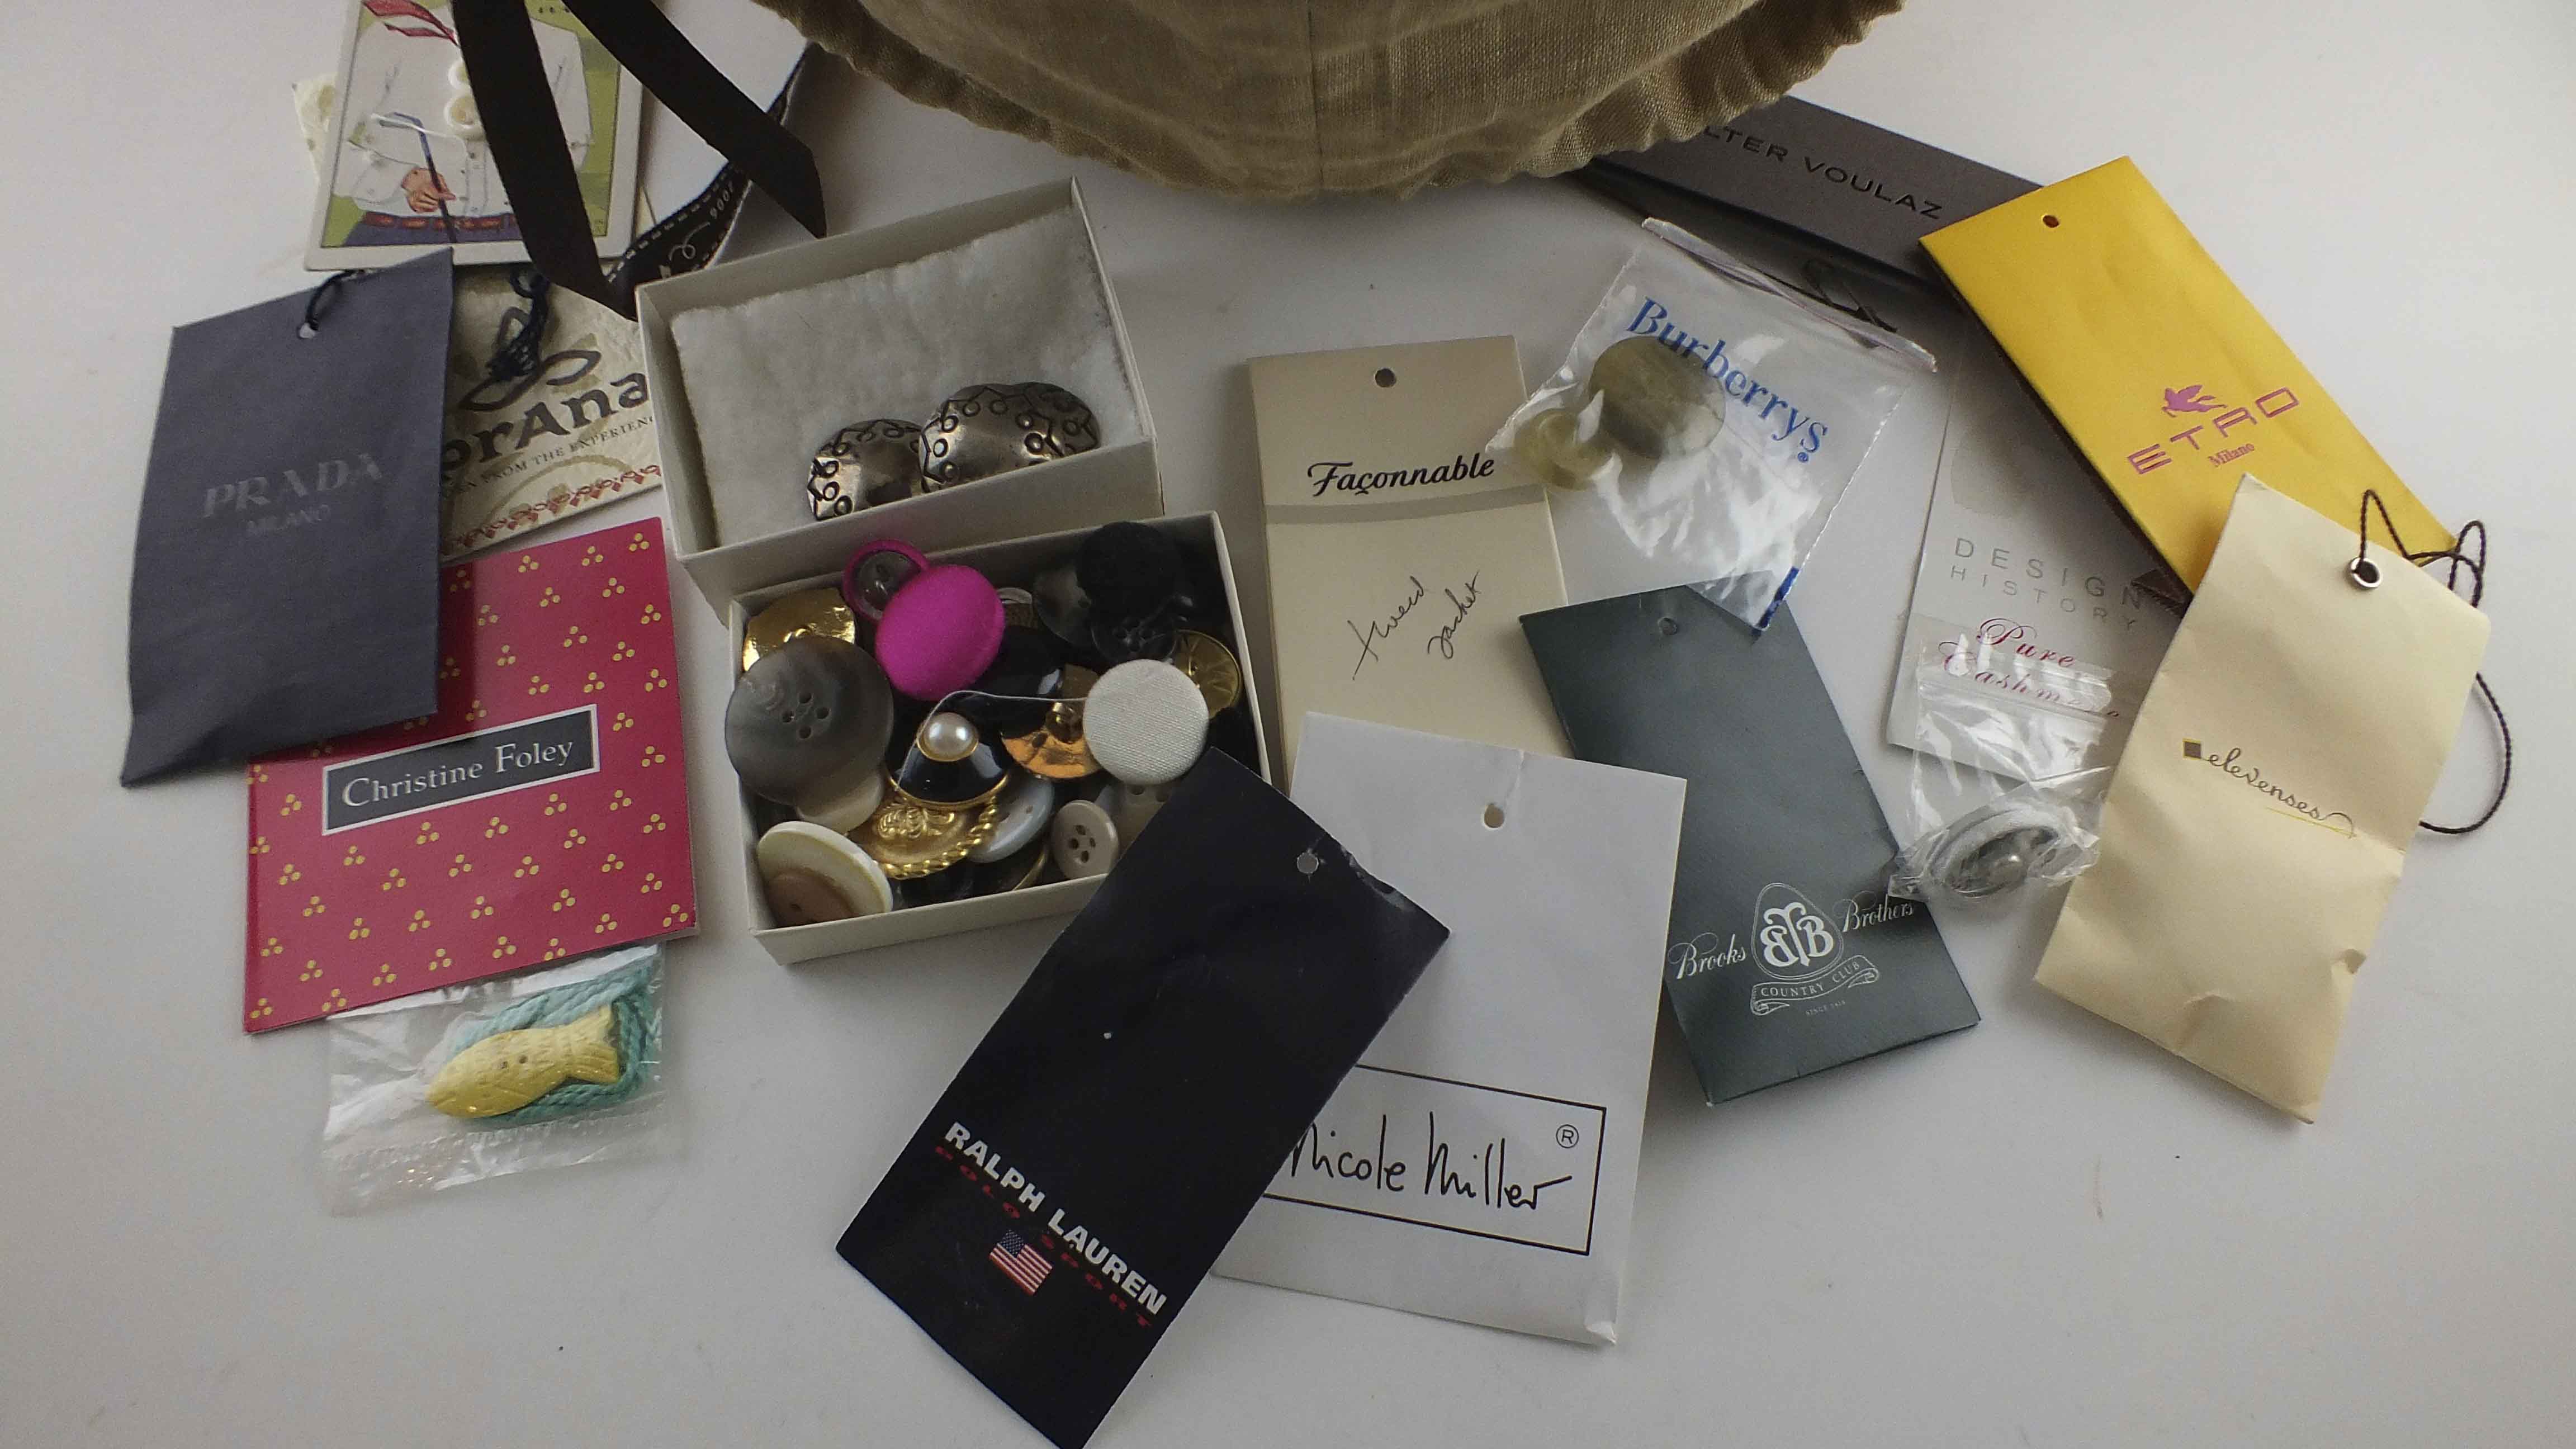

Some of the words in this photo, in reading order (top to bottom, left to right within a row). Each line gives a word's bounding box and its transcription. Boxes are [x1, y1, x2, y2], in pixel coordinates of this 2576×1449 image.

[1704, 125, 1788, 162] LTER
[1803, 156, 1943, 220] VOULAZ
[1626, 296, 1828, 453] Burberrys
[533, 447, 565, 466] THE
[569, 415, 654, 453] EXPERIEN
[2127, 386, 2299, 475] ETRO
[2208, 443, 2255, 468] Milano
[201, 453, 382, 518] PRADA
[1307, 453, 1494, 497] Façonnable
[1950, 564, 2136, 631] HISTORY
[1955, 537, 2143, 610] DESIGN
[1976, 618, 2075, 668] Pure
[342, 764, 484, 807] Christine
[495, 741, 573, 773] Foley
[2201, 747, 2354, 838] elevenses
[1833, 890, 1915, 932] Brothers
[1668, 932, 1746, 979] Brooks
[1760, 982, 1825, 998] COUNTRY
[1832, 960, 1860, 983] CLUB
[1291, 1114, 1406, 1192] Nicole
[1424, 1111, 1573, 1210] Miller
[944, 1121, 1046, 1213] RALPH
[1048, 1208, 1167, 1315] LAUREN
